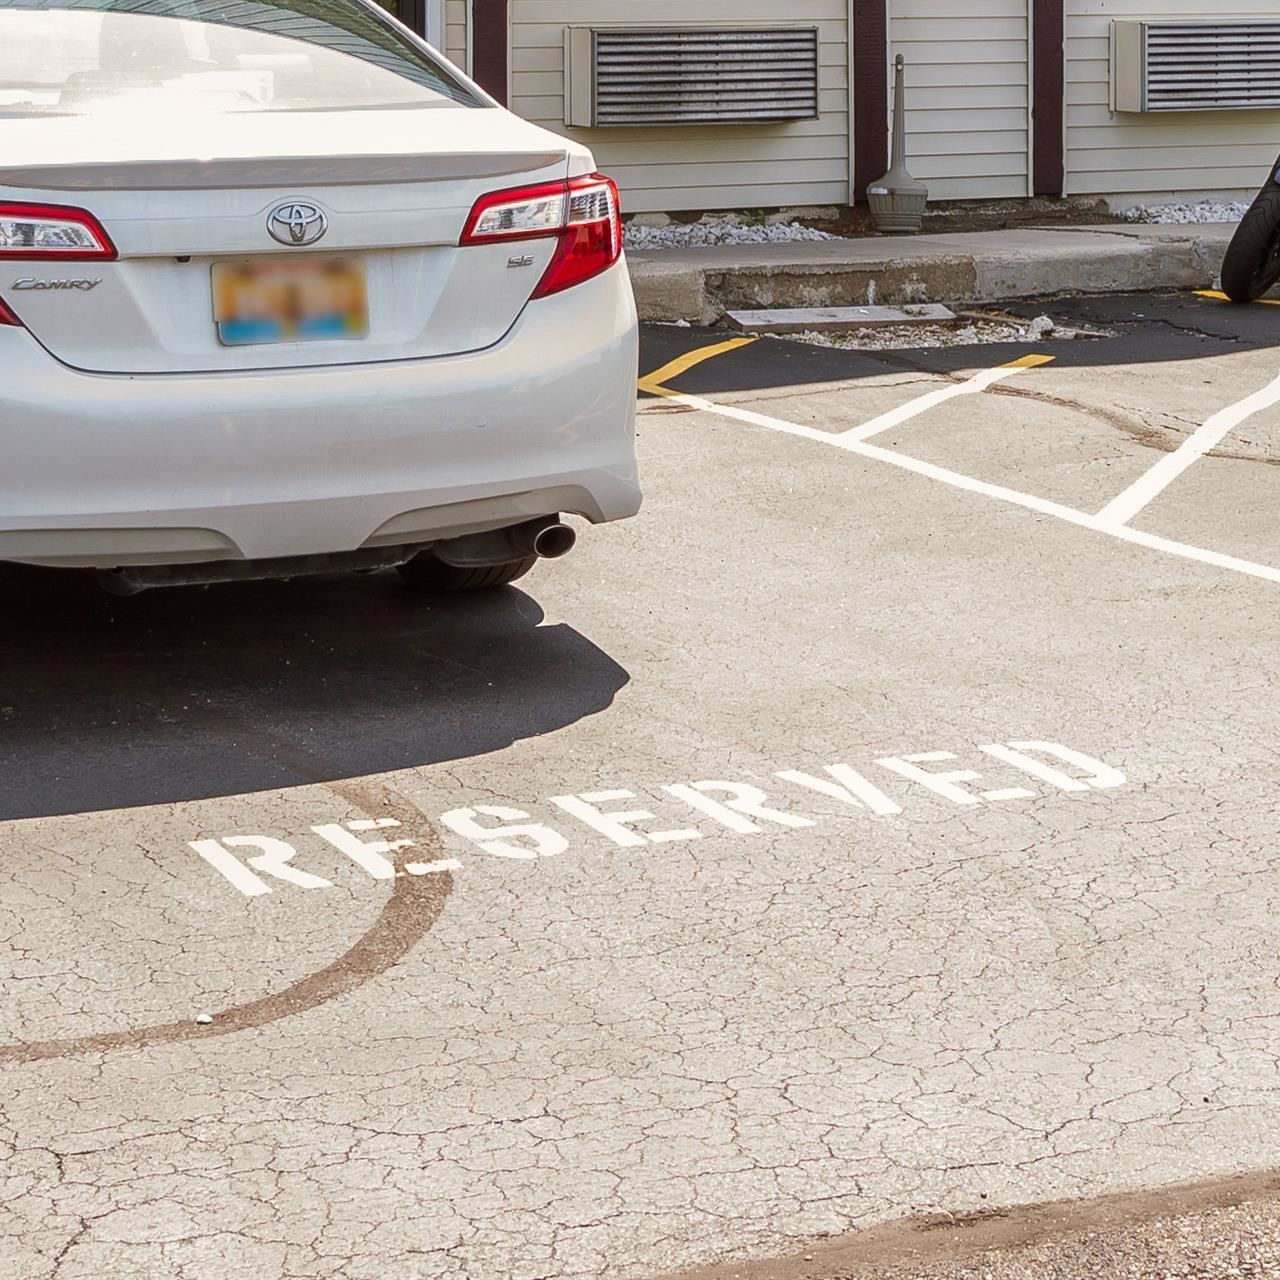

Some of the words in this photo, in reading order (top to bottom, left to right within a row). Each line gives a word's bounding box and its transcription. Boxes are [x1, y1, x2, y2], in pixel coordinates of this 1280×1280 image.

[506, 254, 535, 269] SE
[11, 277, 103, 292] CAMRY
[187, 739, 1130, 898] RESERVED
